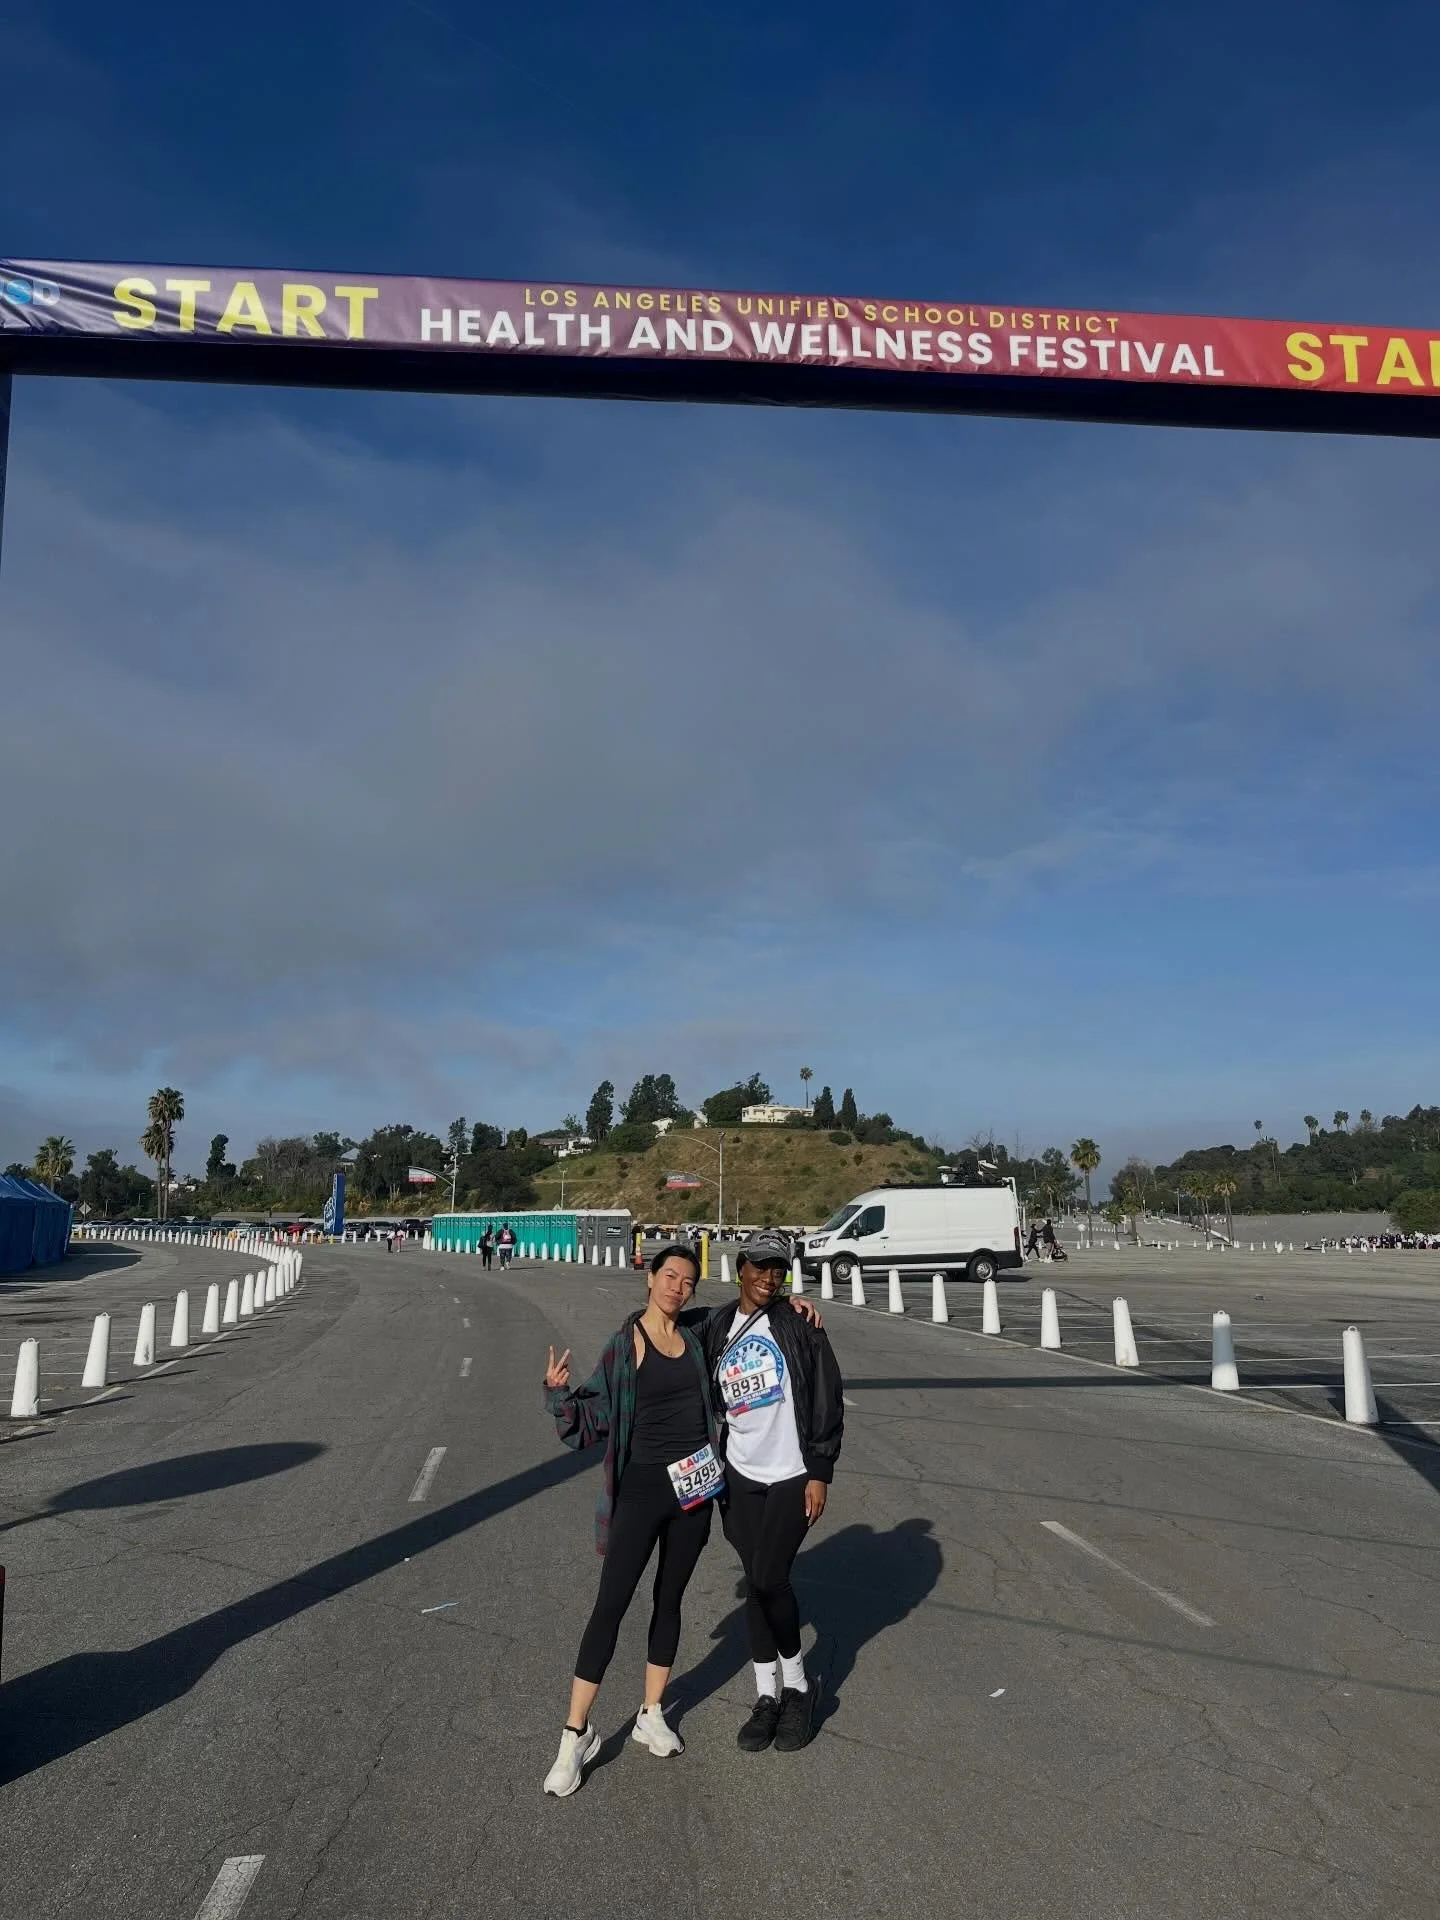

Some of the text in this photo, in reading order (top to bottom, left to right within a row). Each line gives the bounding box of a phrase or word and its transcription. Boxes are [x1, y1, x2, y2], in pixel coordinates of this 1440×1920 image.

[112, 278, 378, 340] START
[525, 288, 1120, 334] LOS ANGELES UNIFIED SCHOOL DISTRICT
[420, 308, 1225, 378] HEALTH AND WELLNESS FESTIVAL
[1285, 332, 1440, 389] STA
[726, 1359, 763, 1377] LAUSD
[731, 1374, 766, 1398] 8931
[678, 1448, 709, 1471] LAUSD
[682, 1462, 717, 1493] 3499
